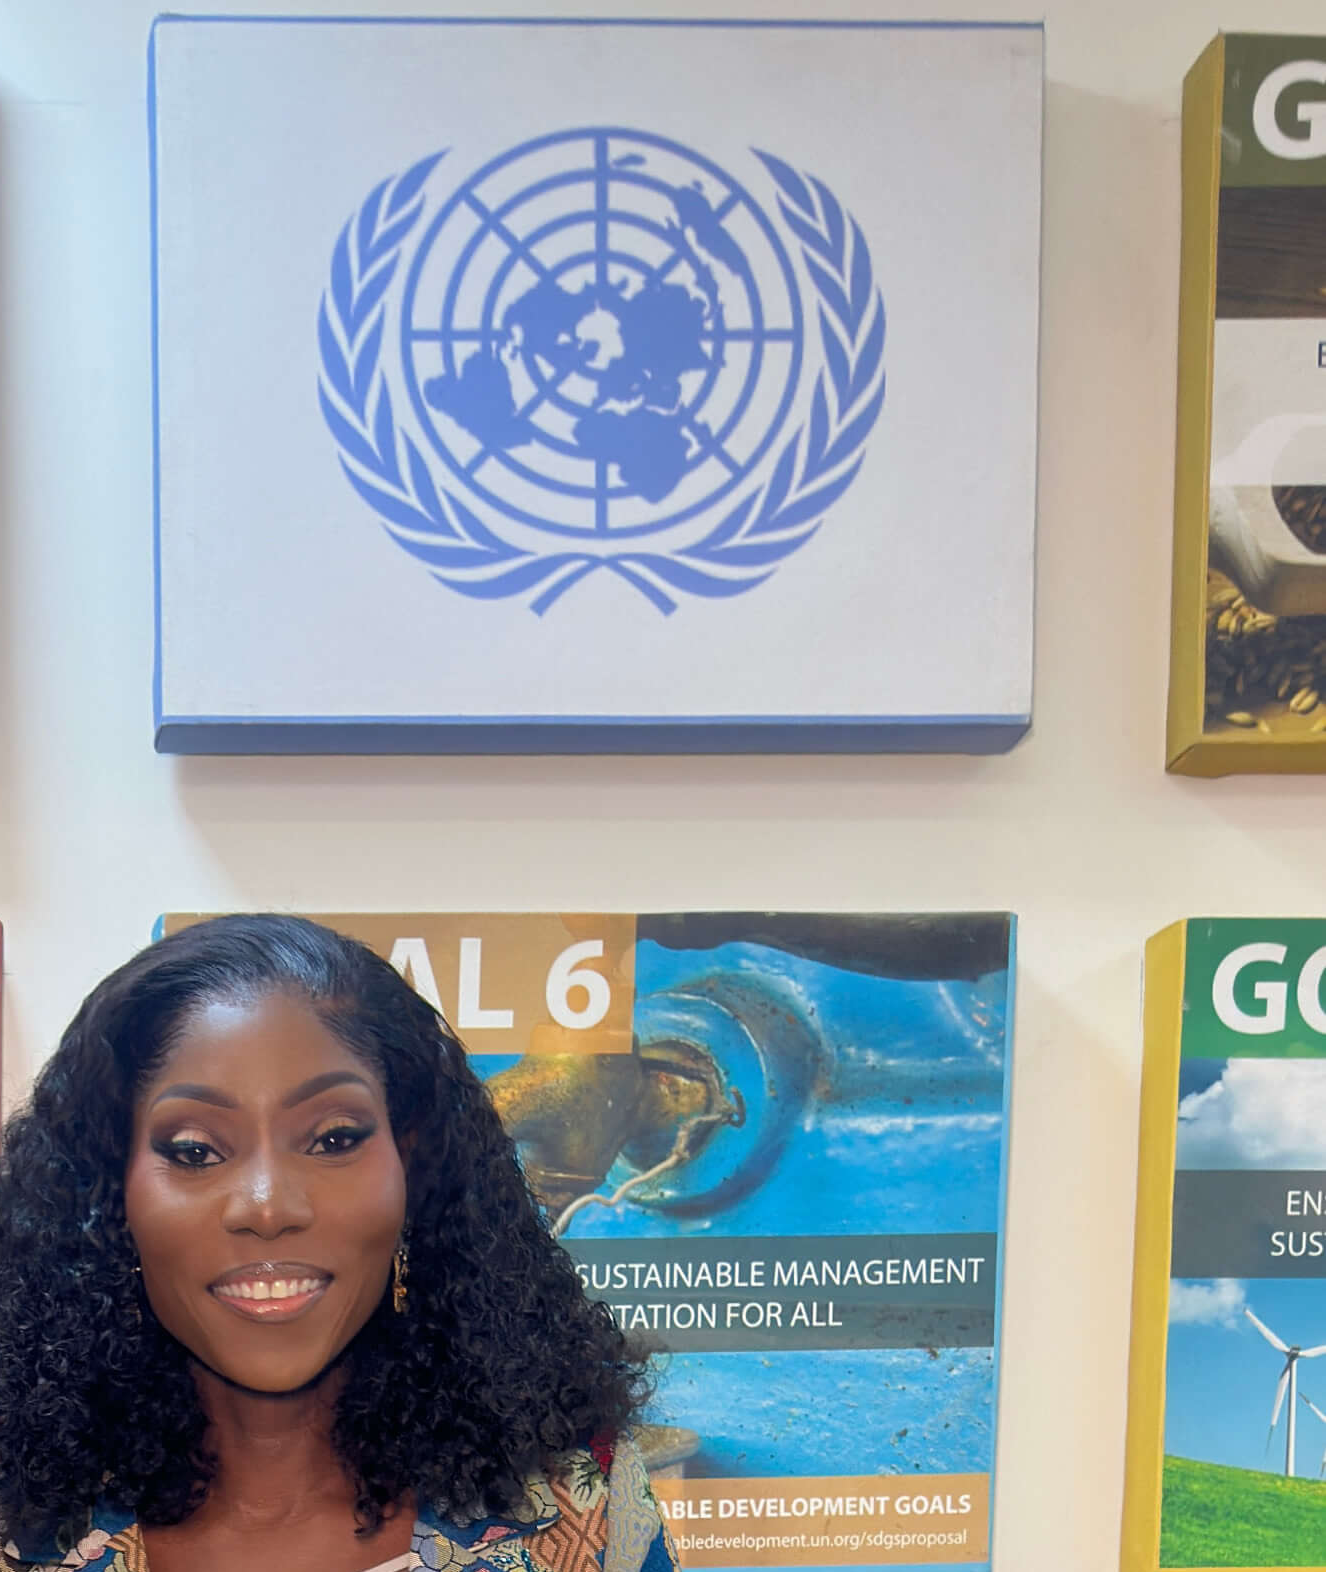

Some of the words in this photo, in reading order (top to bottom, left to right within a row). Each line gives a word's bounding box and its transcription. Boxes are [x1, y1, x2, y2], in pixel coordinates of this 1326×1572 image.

[546, 939, 611, 1029] 6
[1286, 1190, 1326, 1216] EN
[1271, 1231, 1326, 1257] SUS
[575, 1261, 765, 1289] SUSTAINABLE
[773, 1257, 985, 1287] MANAGEMENT
[610, 1303, 717, 1329] TATION
[726, 1302, 783, 1328] FOR
[790, 1301, 843, 1327] ALL
[718, 1496, 890, 1518] DEVELOPMENT
[894, 1494, 971, 1515] GOALS
